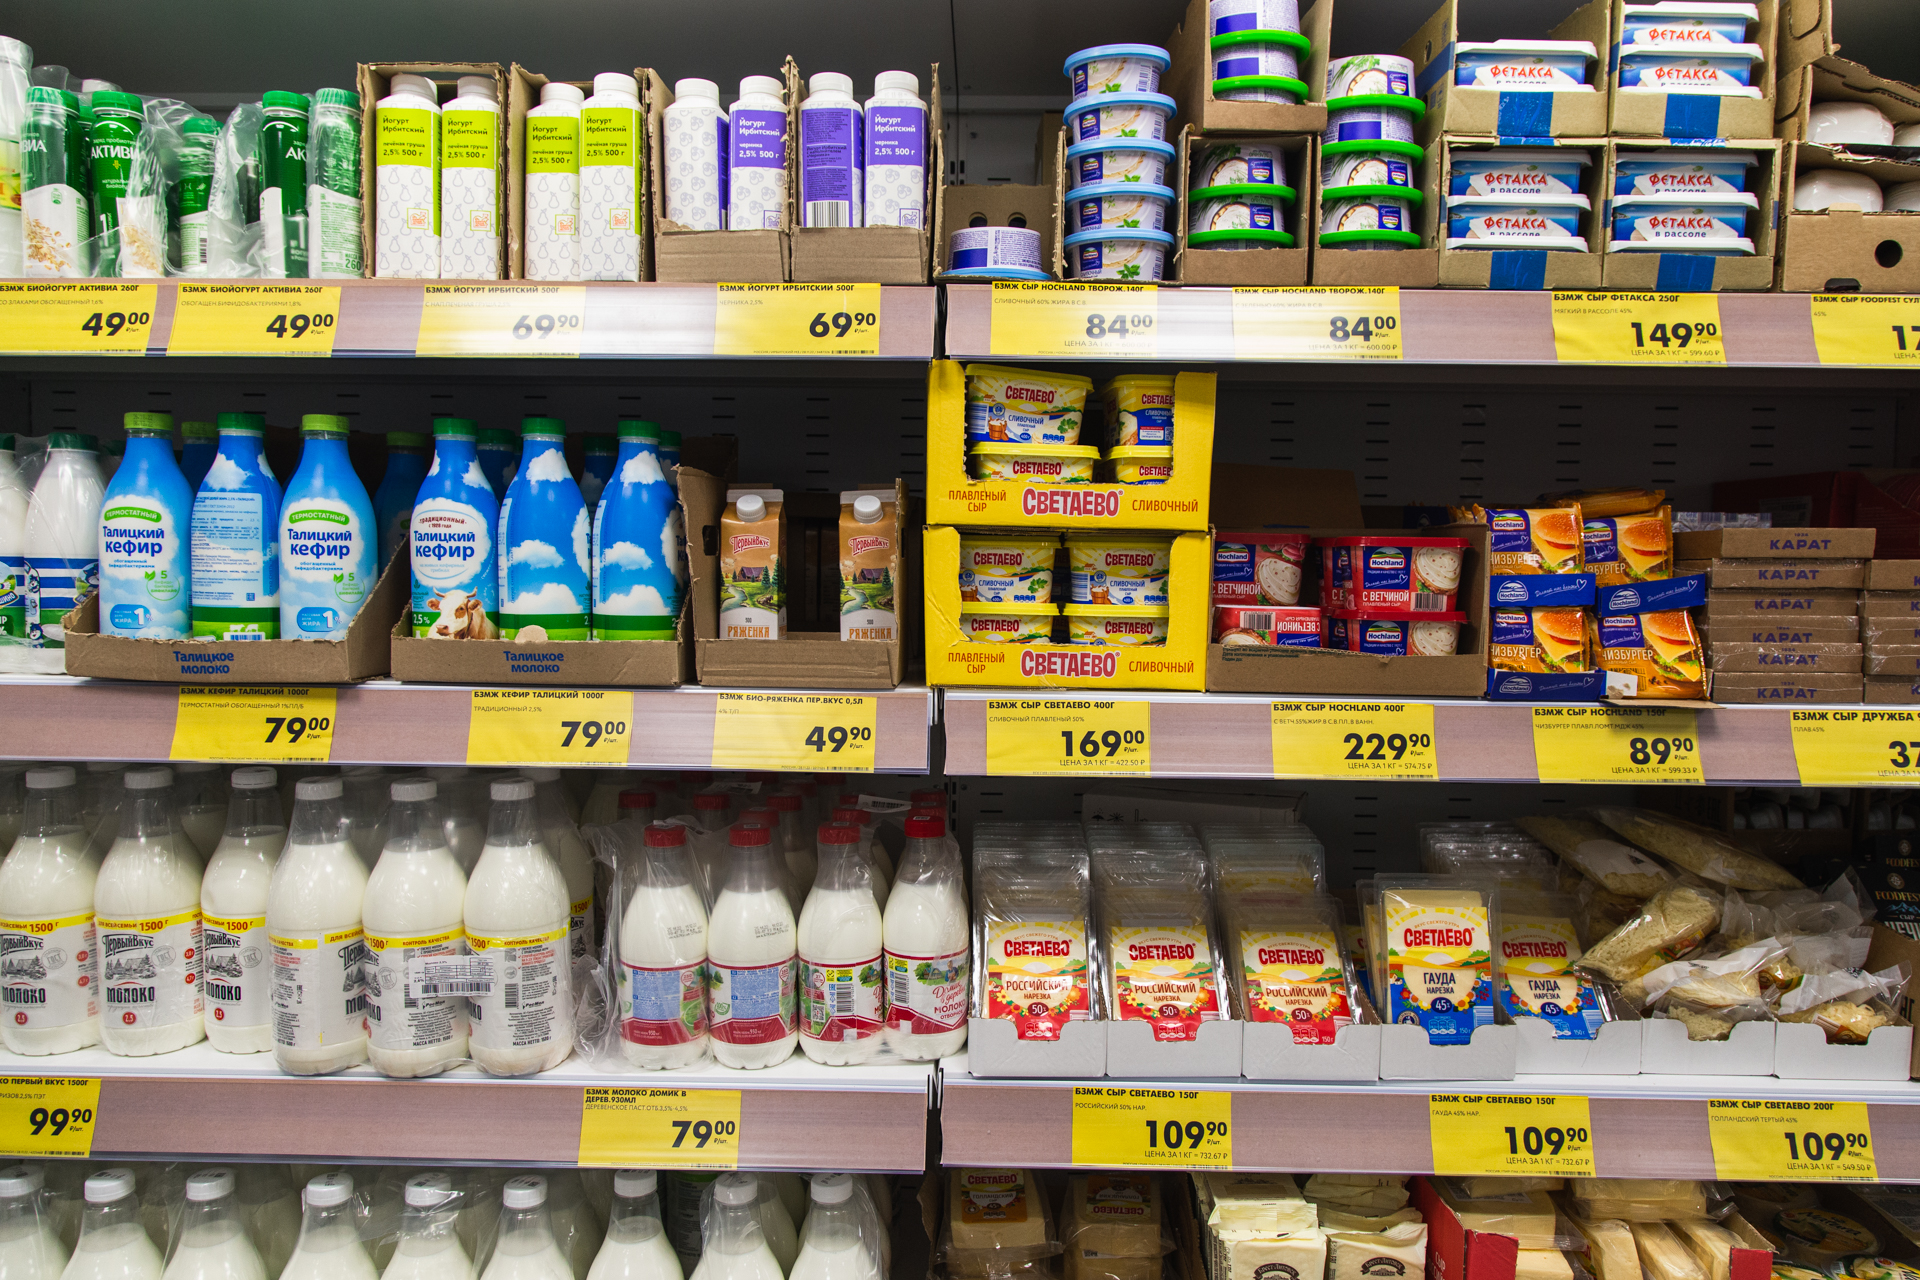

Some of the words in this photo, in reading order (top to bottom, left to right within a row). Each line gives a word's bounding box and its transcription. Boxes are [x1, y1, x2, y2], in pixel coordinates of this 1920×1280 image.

[1649, 28, 1712, 42] ФЕТАКСА
[1490, 65, 1553, 79] ФЕТАКСА
[1655, 67, 1718, 80] ФЕТАКСА
[383, 116, 409, 125] Йогурт
[875, 115, 901, 124] Йогурт
[383, 126, 424, 135] Ирбитский
[874, 124, 916, 134] Ирбитский
[402, 149, 417, 157] 500
[874, 148, 892, 156] 2,5%
[895, 148, 910, 156] 500
[1649, 173, 1713, 188] ФЕТАКСА
[1649, 216, 1713, 231] ФЕТАКСА
[1006, 386, 1054, 403] СВЕТАЕВО
[949, 489, 1006, 501] ПЛАВЛЕНЫЙ
[968, 502, 987, 512] СЫР
[1023, 488, 1119, 516] СВЕТАЕВО
[1132, 500, 1198, 512] СЛИВОЧНЫЙ
[103, 526, 164, 540] Талицкий
[288, 529, 352, 542] Талицкий
[414, 531, 475, 543] Талицкий
[105, 539, 163, 558] кефир
[1770, 540, 1831, 549] КАРАТ
[291, 542, 350, 560] кефир
[416, 544, 474, 560] кефир
[974, 552, 1022, 566] СВЕТАЕВО
[1218, 553, 1248, 561] Hochland
[1372, 559, 1403, 567] Hochland
[1363, 592, 1368, 601] С
[1370, 591, 1409, 602] ВЕТЧИНОЙ
[1755, 599, 1814, 609] КАРАТ
[728, 626, 769, 637] РЯЖЕНКА
[173, 651, 234, 662] Талицкое
[504, 651, 564, 662] Талицкое
[948, 652, 1005, 664] ПЛАВЛЕНЫЙ
[181, 664, 230, 674] молоко
[512, 663, 560, 672] молоко
[967, 664, 986, 674] СЫР
[1021, 650, 1116, 677] СВЕТАЕВО
[1129, 661, 1194, 673] СЛИВОЧНЫЙ
[239, 688, 284, 696] ТАЛИЦКИЙ
[533, 691, 578, 699] ТАЛИЦКИЙ
[746, 695, 803, 703] БИО-РЯЖЕНКА
[1793, 712, 1828, 720] БЗМЖ
[1833, 712, 1858, 721] СЫР
[1862, 713, 1913, 722] ДРУЖБА
[139, 921, 163, 931] 1500
[1404, 927, 1472, 947] СВЕТАЕВО
[1129, 944, 1194, 960] СВЕТАЕВО
[1502, 941, 1567, 958] СВЕТАЕВО
[1258, 948, 1324, 965] СВЕТАЕВО
[1424, 972, 1456, 986] ГАУДА
[1427, 986, 1454, 994] НАРЕЗКА
[1130, 1090, 1175, 1098] СВЕТАЕВО
[968, 1173, 1017, 1185] СВЕТАЕВО
